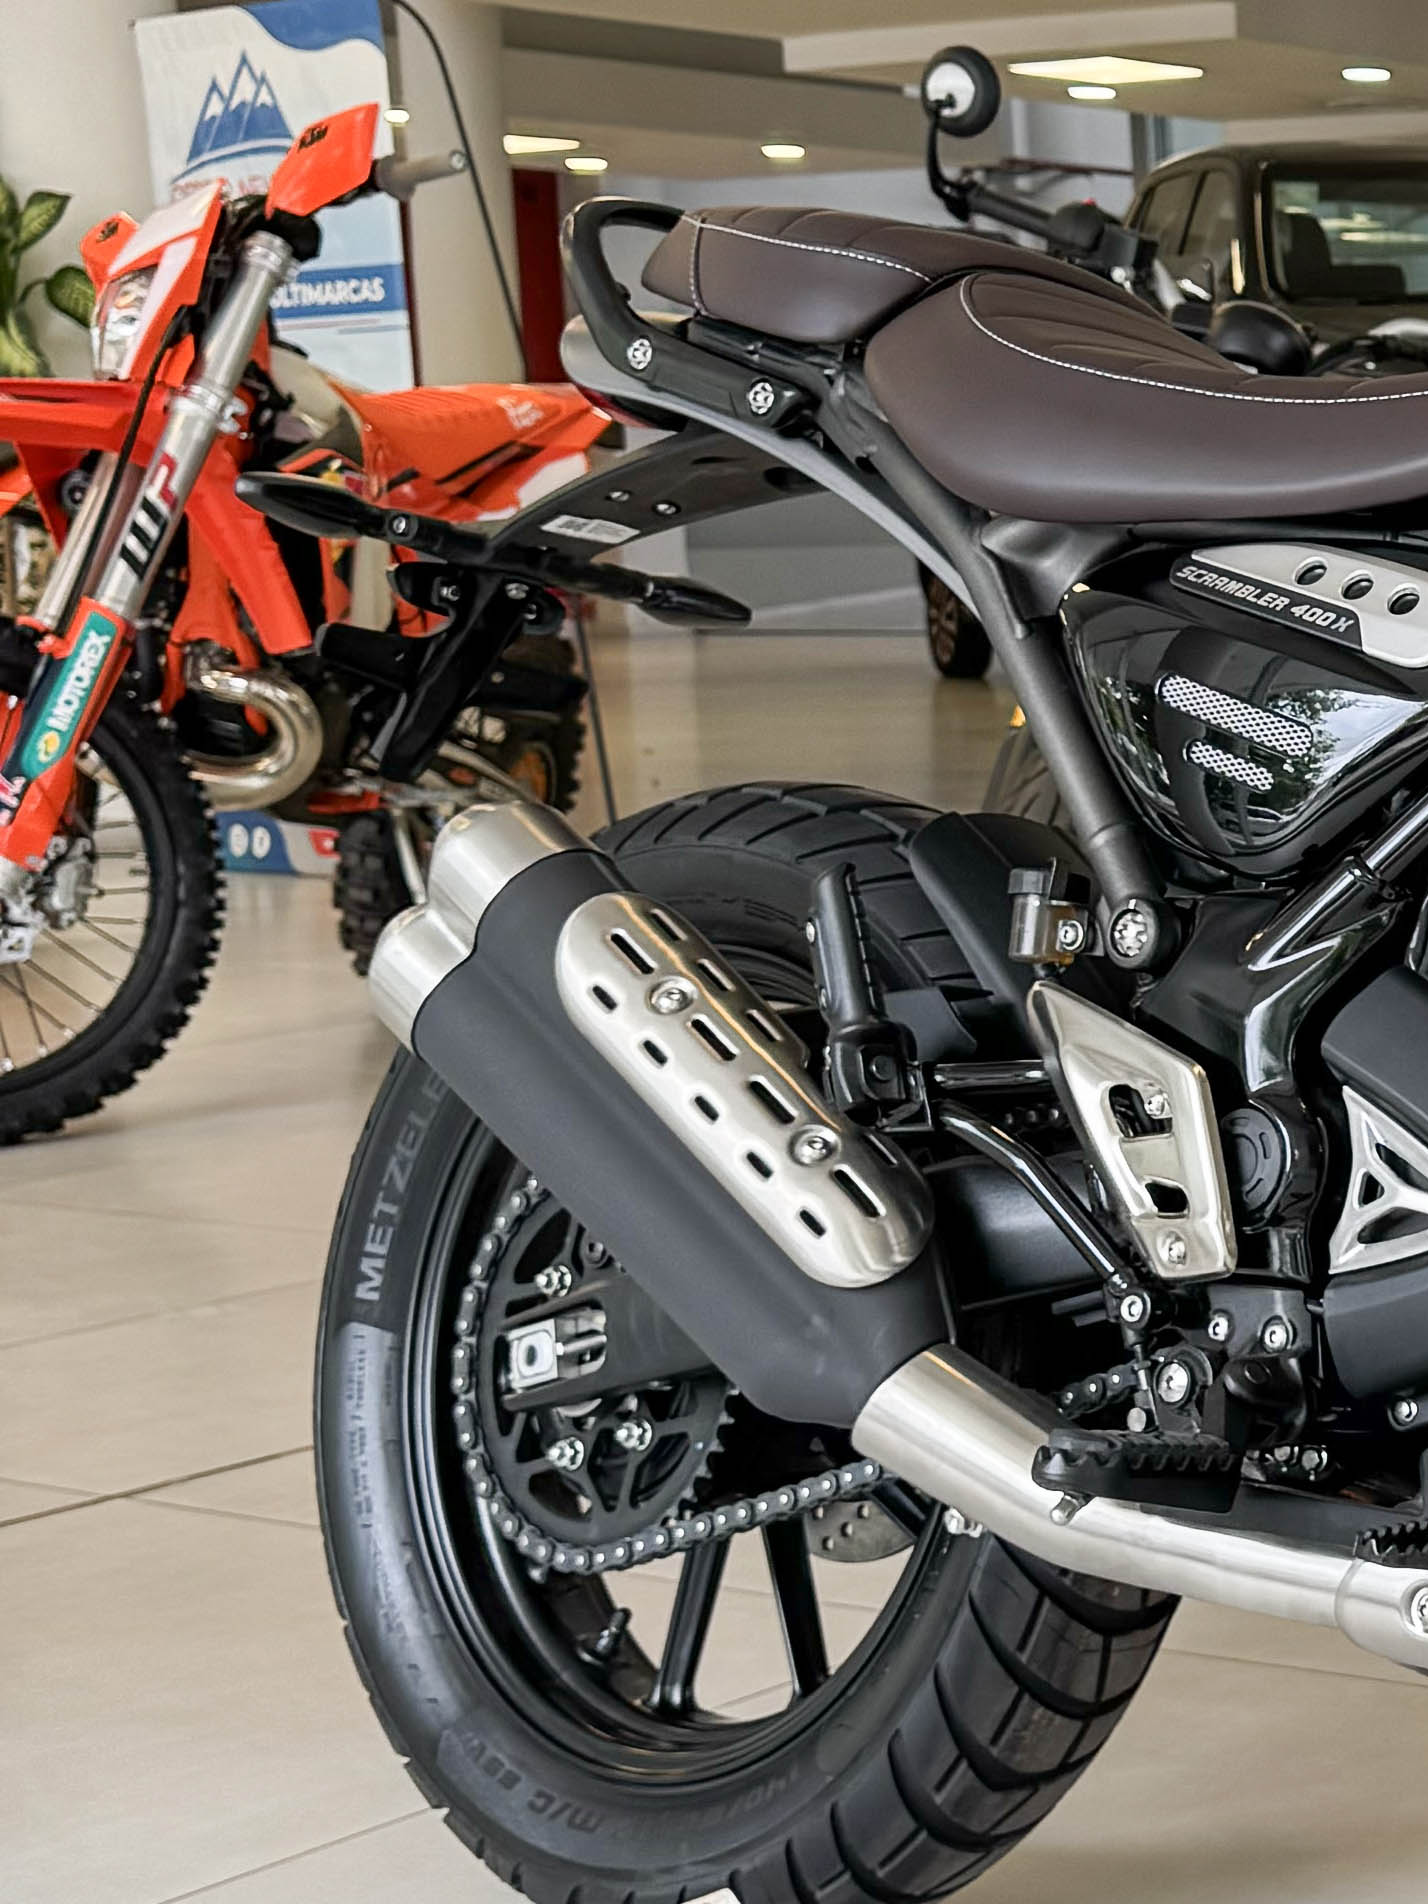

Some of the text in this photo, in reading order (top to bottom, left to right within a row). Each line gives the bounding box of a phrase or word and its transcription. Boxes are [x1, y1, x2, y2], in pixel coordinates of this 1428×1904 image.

[269, 277, 386, 309] ULTIMARCAS
[1175, 565, 1291, 612] SCRAMBLER
[46, 629, 112, 733] MOTOREX
[355, 1070, 449, 1302] METZELE
